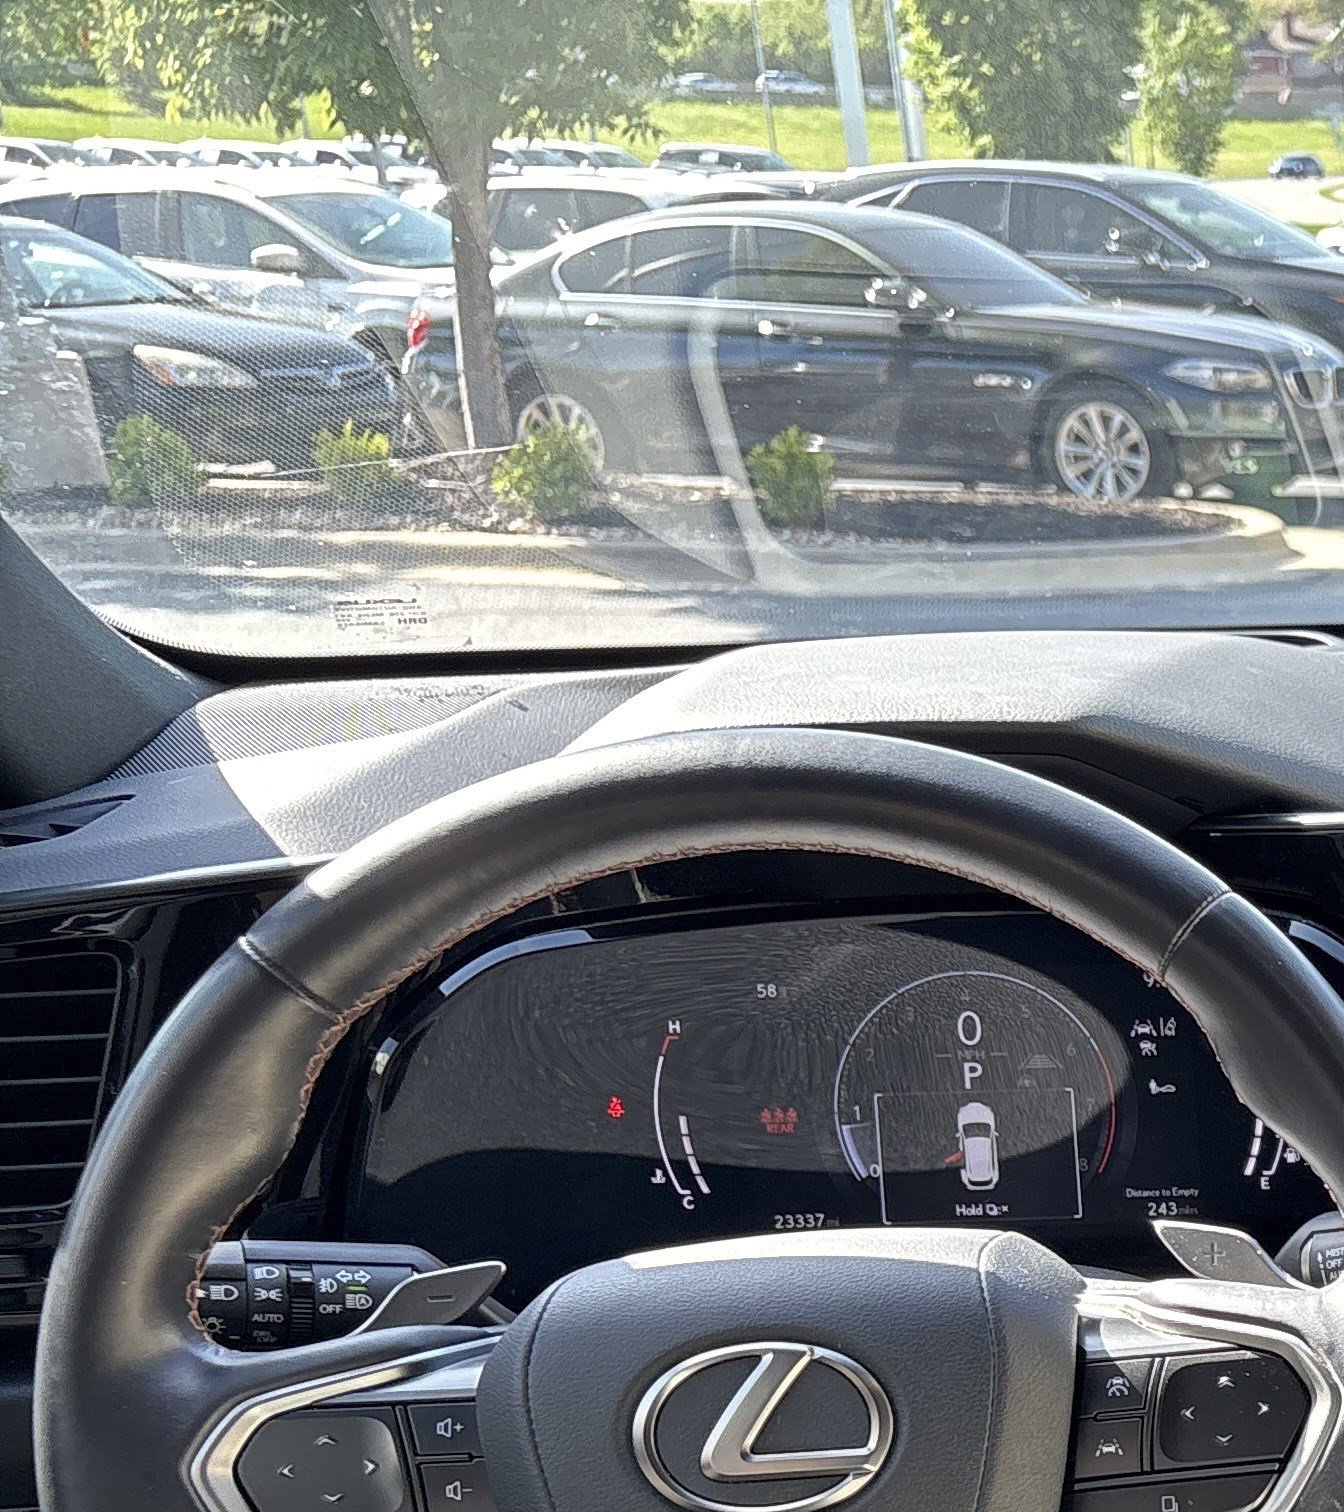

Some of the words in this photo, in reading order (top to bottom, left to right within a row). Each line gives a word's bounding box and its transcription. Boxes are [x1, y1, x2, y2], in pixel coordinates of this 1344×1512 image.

[756, 982, 777, 999] 58
[667, 1019, 682, 1034] H
[957, 1010, 982, 1046] 0
[957, 1049, 986, 1061] MPH
[1066, 1042, 1077, 1057] 6
[963, 1062, 983, 1090] P
[853, 1105, 861, 1121] 1
[766, 1122, 795, 1134] REAR
[869, 1163, 881, 1179] 0
[1079, 1158, 1088, 1172] 8
[1260, 1176, 1271, 1190] E
[1125, 1187, 1160, 1198] Distance
[1161, 1188, 1171, 1198] to
[1171, 1187, 1199, 1199] Empty
[682, 1195, 695, 1211] C
[955, 1203, 983, 1217] Hold
[1148, 1202, 1178, 1216] 243
[774, 1212, 826, 1230] 23337
[826, 1216, 840, 1228] mi
[1325, 1258, 1343, 1270] OFF
[319, 1303, 343, 1315] OFF
[251, 1313, 285, 1323] AUTO
